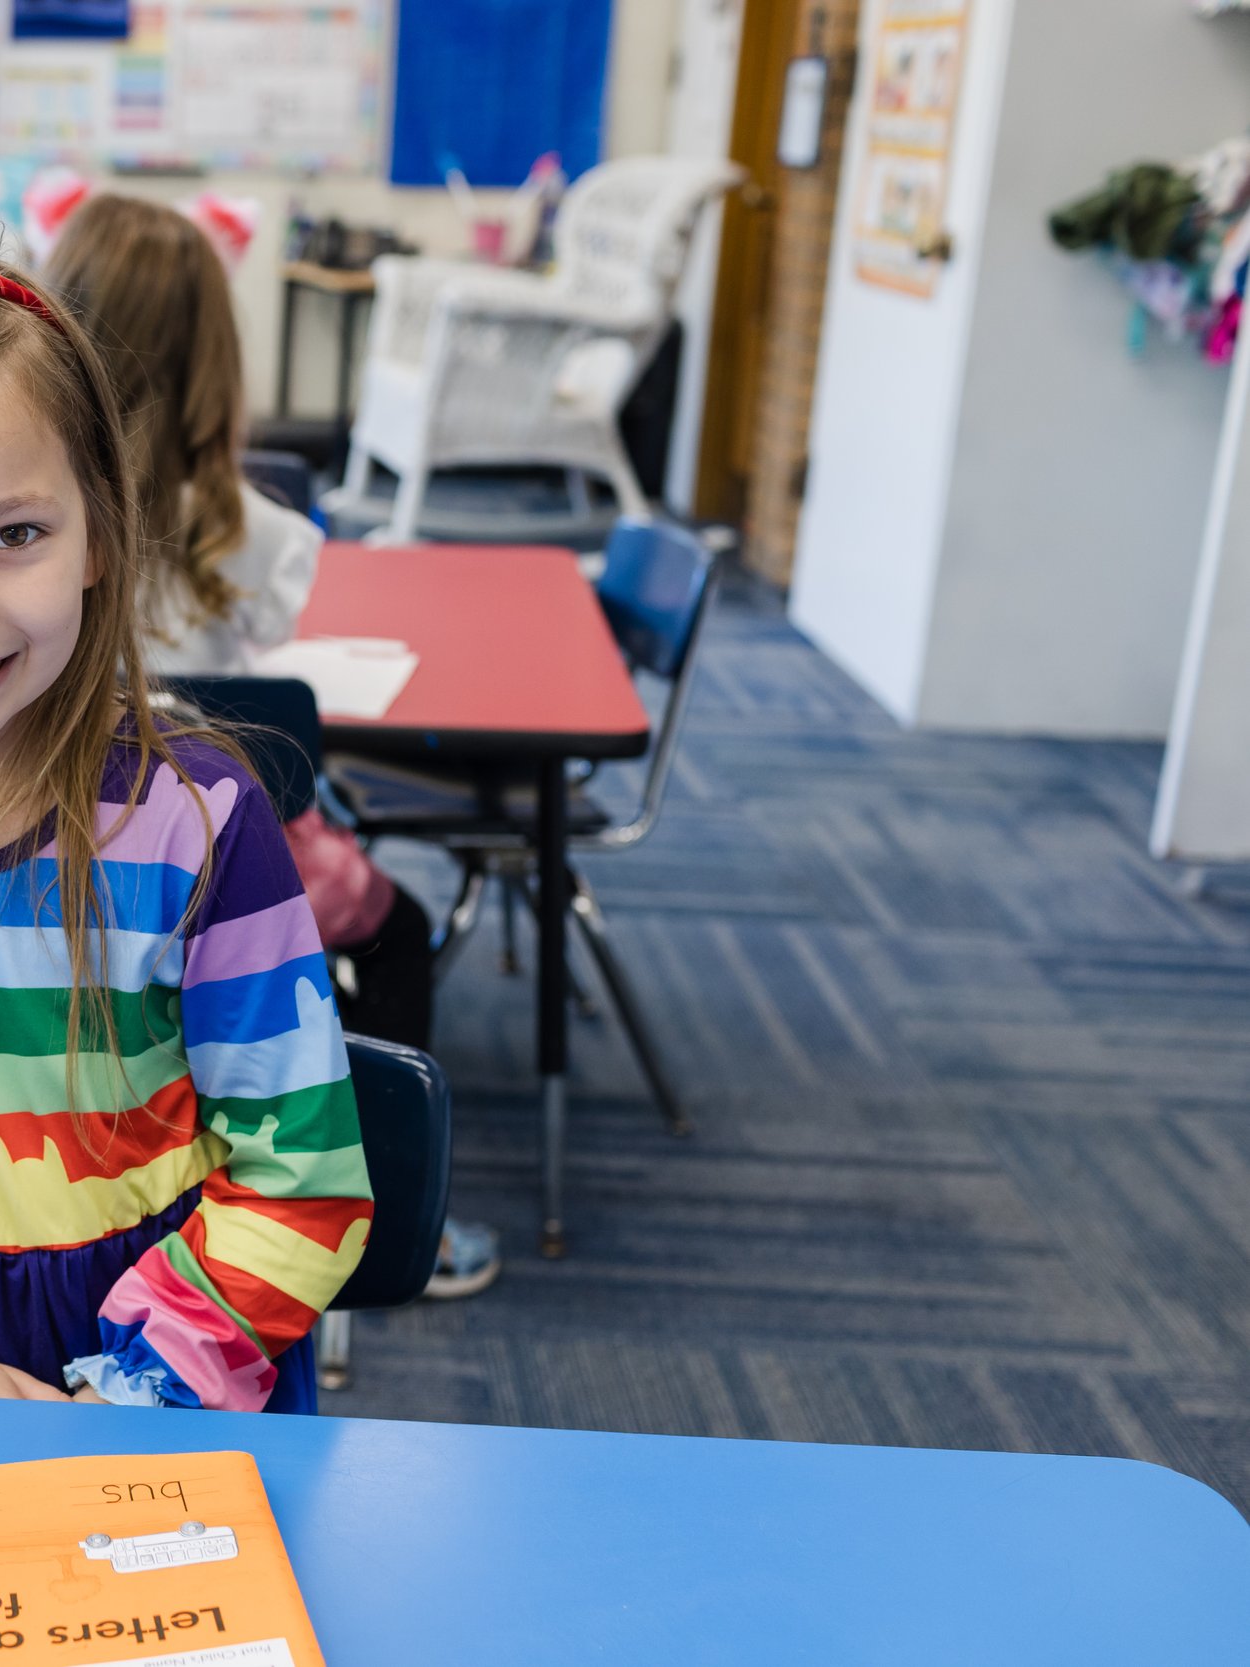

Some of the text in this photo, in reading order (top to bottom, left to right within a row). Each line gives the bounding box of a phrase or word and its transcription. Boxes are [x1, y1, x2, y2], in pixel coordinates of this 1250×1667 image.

[101, 1480, 188, 1512] bus
[143, 1544, 170, 1554] BUS
[46, 1606, 227, 1644] Letters
[144, 1645, 271, 1667] Print Child's Name
